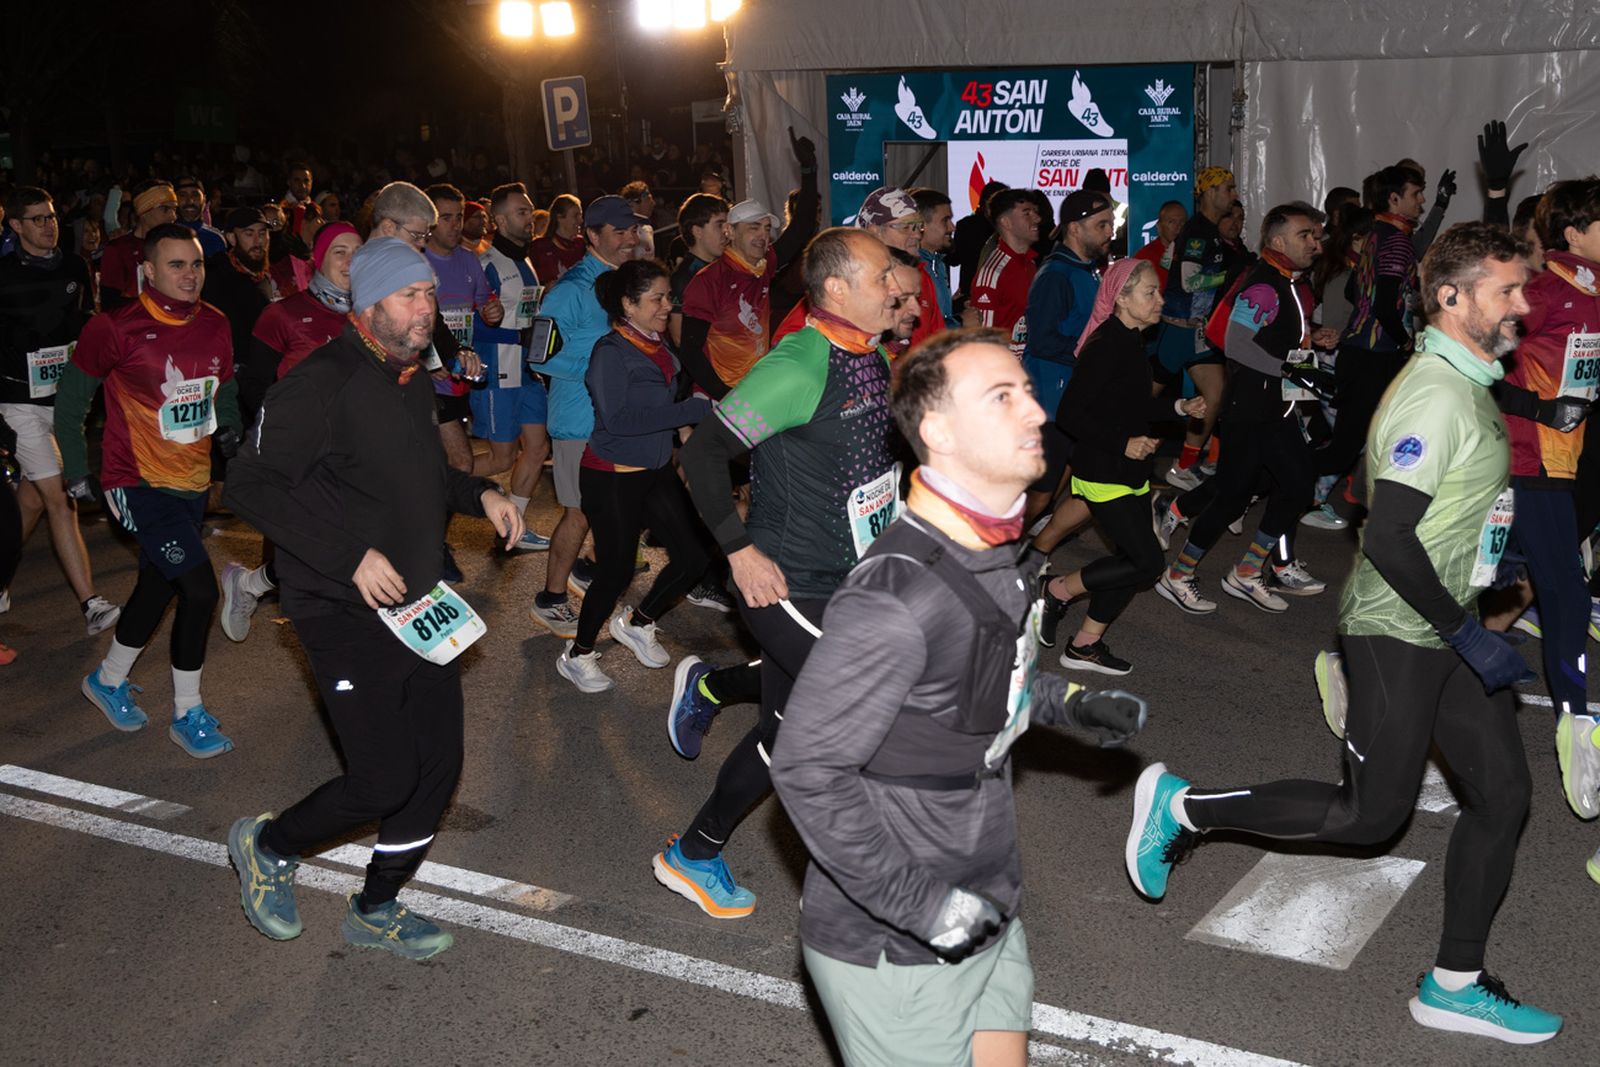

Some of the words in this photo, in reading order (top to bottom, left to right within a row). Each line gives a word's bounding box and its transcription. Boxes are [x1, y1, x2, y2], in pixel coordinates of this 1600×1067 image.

[961, 80, 993, 108] 43
[993, 79, 1048, 105] SAN
[188, 104, 224, 127] WC
[553, 86, 579, 141] P
[907, 111, 923, 129] 43
[953, 101, 1044, 134] ANTÓN
[1082, 107, 1099, 127] 43
[1138, 108, 1156, 116] CAJA
[1157, 107, 1181, 115] RURAL
[1041, 149, 1071, 157] CARRERA
[1040, 159, 1068, 167] NOCHE
[1069, 159, 1081, 167] DE
[832, 171, 880, 181] calderón
[1037, 168, 1079, 188] SAN
[1132, 171, 1188, 181] calderón
[859, 503, 875, 516] SAN
[397, 611, 413, 626] SAN
[411, 601, 460, 642] 8146
